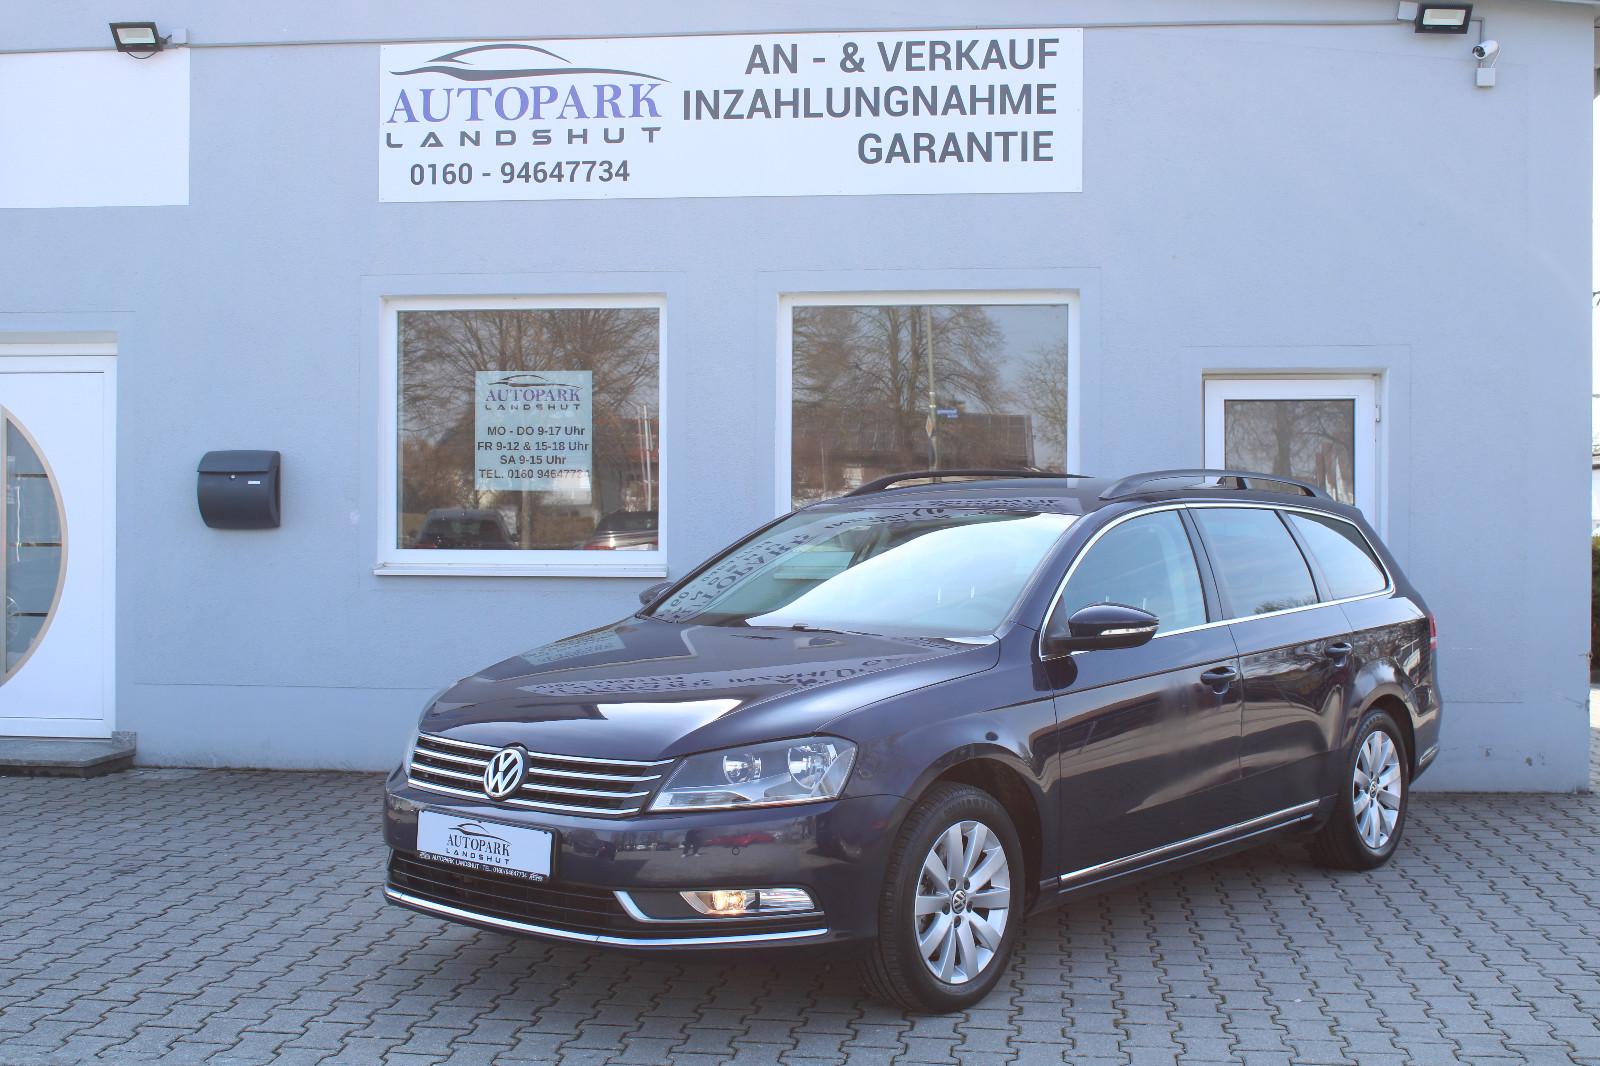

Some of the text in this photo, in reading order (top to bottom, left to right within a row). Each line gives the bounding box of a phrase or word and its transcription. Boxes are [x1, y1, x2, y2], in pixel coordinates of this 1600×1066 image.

[745, 43, 798, 74] AN
[839, 42, 865, 73] &
[877, 38, 1060, 72] VERKAUF
[386, 84, 663, 123] AUTOPARK
[683, 83, 1057, 120] INZAHLUNGNAHME
[386, 126, 662, 148] LANDSHUT
[857, 131, 1054, 164] GARANTIE
[410, 162, 473, 185] 0160
[500, 160, 630, 183] 94647734
[485, 388, 580, 402] AUTOPARK
[485, 403, 580, 411] LANDSHUT
[487, 426, 506, 435] MO
[516, 426, 534, 435] DO
[538, 426, 561, 435] 9-17
[564, 426, 585, 435] Uhr
[477, 441, 589, 451] FR 9-12 & 15-18 Uhr
[500, 455, 567, 464] SA 9-15 Uhr
[479, 469, 503, 478] TEL.
[507, 469, 533, 478] 0160
[447, 833, 511, 857] AUTOPARK
[446, 848, 510, 865] LANDSHUT
